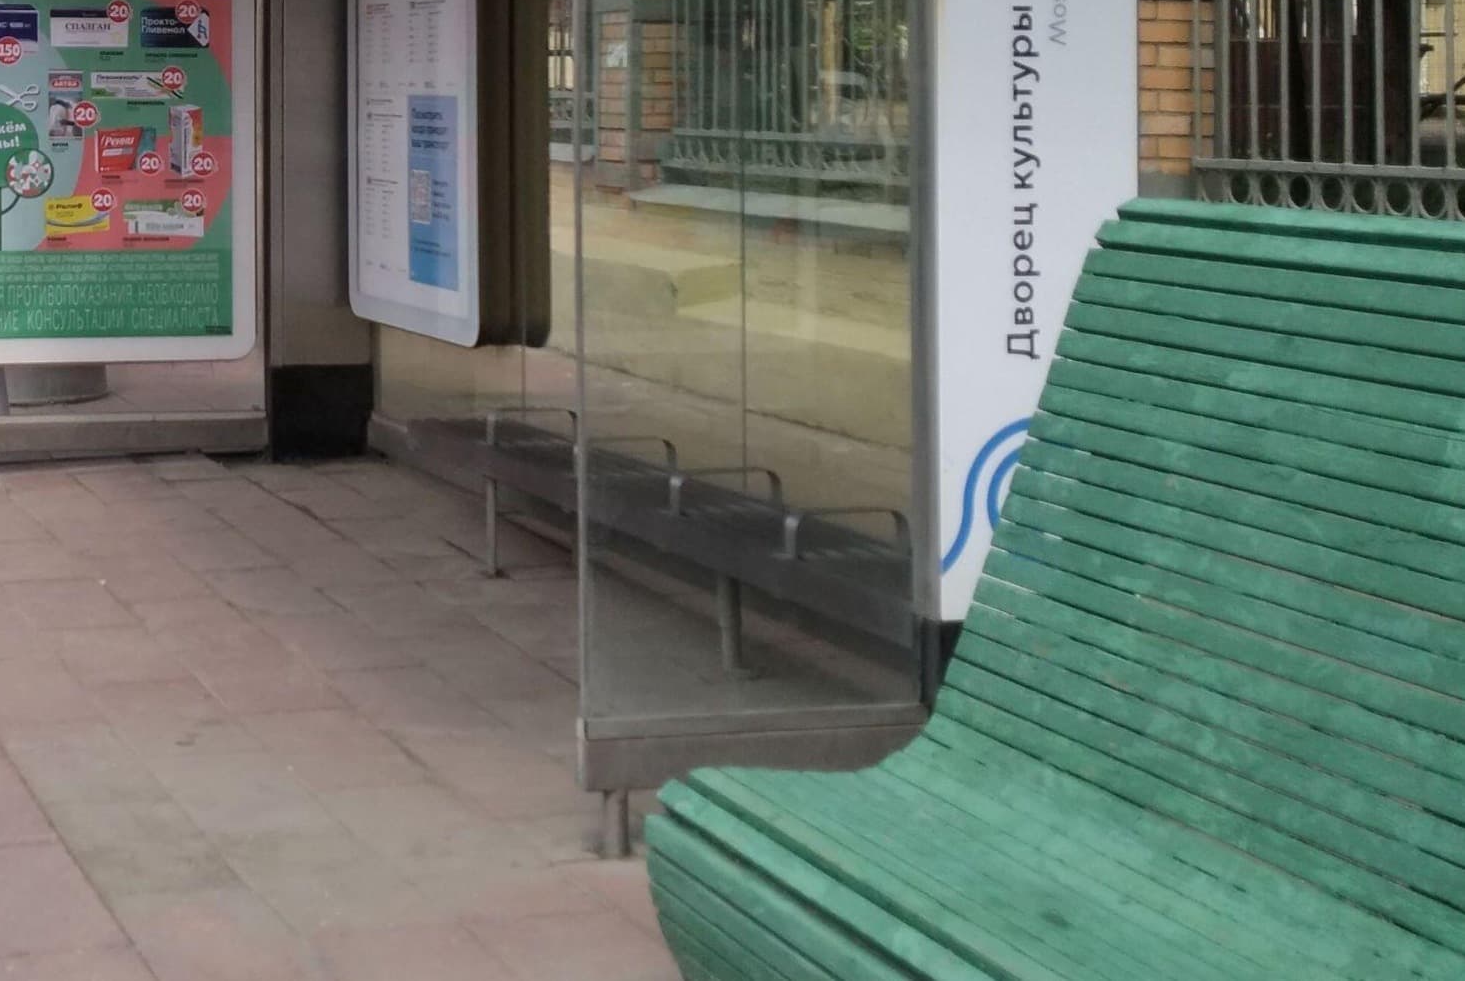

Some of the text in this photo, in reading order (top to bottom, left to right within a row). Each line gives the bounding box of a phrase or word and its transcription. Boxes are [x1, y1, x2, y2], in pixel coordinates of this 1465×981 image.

[109, 5, 128, 18] 20
[179, 5, 197, 17] 20
[164, 72, 182, 85] 20
[1012, 5, 1041, 190] культуры
[76, 108, 96, 121] 20
[141, 157, 160, 170] 20
[193, 158, 213, 170] 20
[94, 194, 112, 206] 20
[184, 194, 203, 206] 20
[1007, 202, 1041, 360] Дворец
